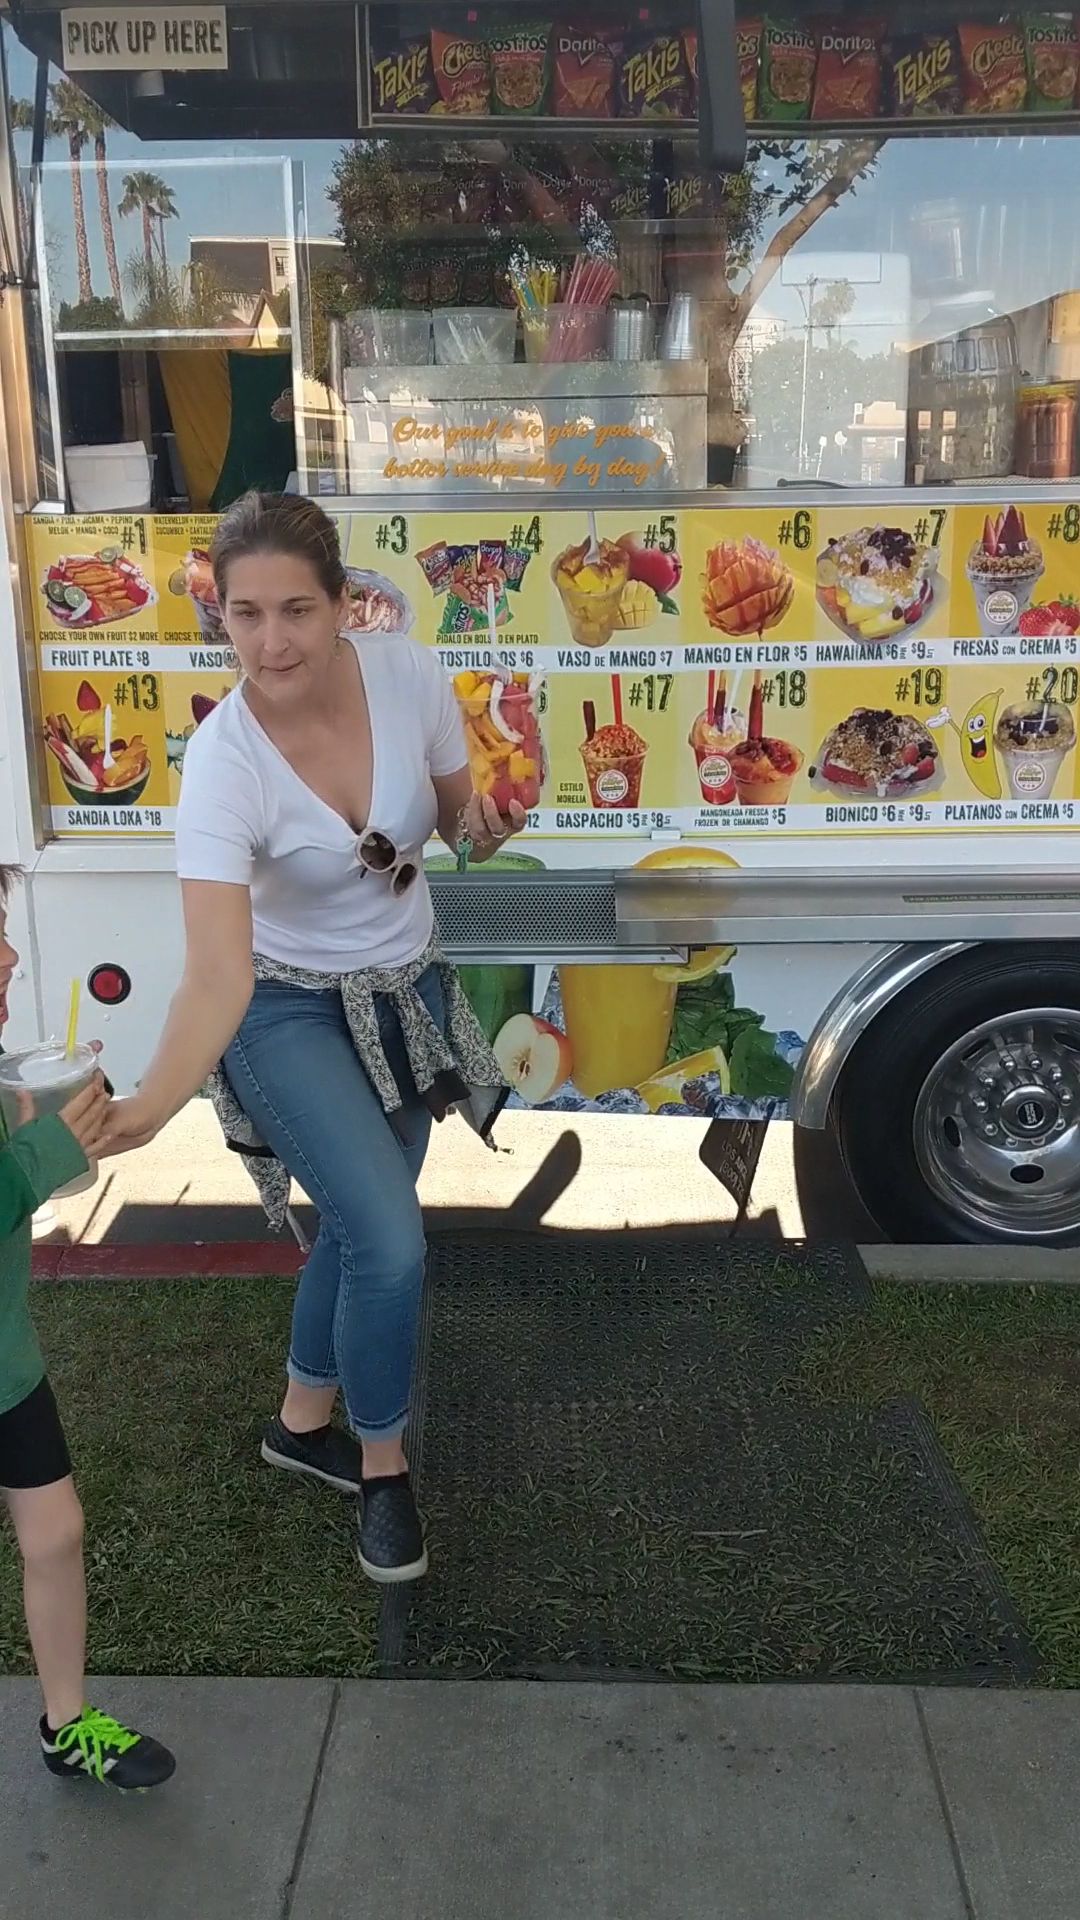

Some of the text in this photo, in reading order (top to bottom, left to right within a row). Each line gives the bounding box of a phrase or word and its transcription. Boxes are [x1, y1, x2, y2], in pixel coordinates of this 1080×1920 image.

[67, 19, 223, 54] PICK UP HERE
[372, 46, 429, 107] Takis
[623, 40, 680, 102] Takis
[893, 39, 951, 104] Takis
[392, 416, 443, 443] Our
[444, 418, 499, 450] goal
[521, 419, 544, 439] to
[548, 421, 589, 448] give
[594, 425, 635, 448] you
[382, 453, 665, 488] better service day by day!
[120, 517, 148, 554] #1
[375, 514, 409, 554] #3
[510, 514, 544, 553] #4
[643, 515, 678, 554] #5
[778, 510, 813, 550] #6
[914, 508, 947, 547] #7
[1047, 503, 1080, 543] #8
[39, 631, 159, 641] CHOOSE YOUR OWN FRUIT $2 MORE
[164, 631, 192, 641] CHOOSE
[436, 634, 462, 644] PIDALO
[463, 634, 473, 644] EN
[474, 634, 492, 644] BOLS
[504, 634, 514, 644] EN
[516, 634, 539, 644] PLATO
[953, 638, 1077, 656] FRESAS CON CREMA $5
[51, 650, 150, 666] FRUIT PLATE $8
[189, 651, 223, 667] VASO
[438, 651, 533, 667] TOSTILOOS $6
[557, 650, 673, 667] VASO DE MANGO $7
[684, 645, 808, 664] MANGO EN FLOR $5
[886, 644, 898, 660] $6
[911, 641, 926, 660] $9
[114, 673, 159, 711] #13
[628, 673, 674, 712] #17
[761, 669, 807, 708] #18
[895, 667, 942, 706] #19
[1026, 666, 1079, 704] #20
[557, 794, 587, 804] MORELIA
[559, 783, 583, 792] ESTILO
[68, 808, 162, 826] SANDIA LOKA $18
[556, 813, 623, 828] GASPACHO
[626, 812, 640, 828] $5
[651, 811, 664, 828] $8
[694, 817, 769, 827] FROZEN OR CHAMANGO
[700, 807, 787, 825] MANGONEADA FRESCA $5
[825, 806, 878, 822] BIONICO
[882, 804, 896, 822] $6
[909, 803, 924, 821] $9
[945, 803, 1074, 820] PLATANOS CON CREMA $5
